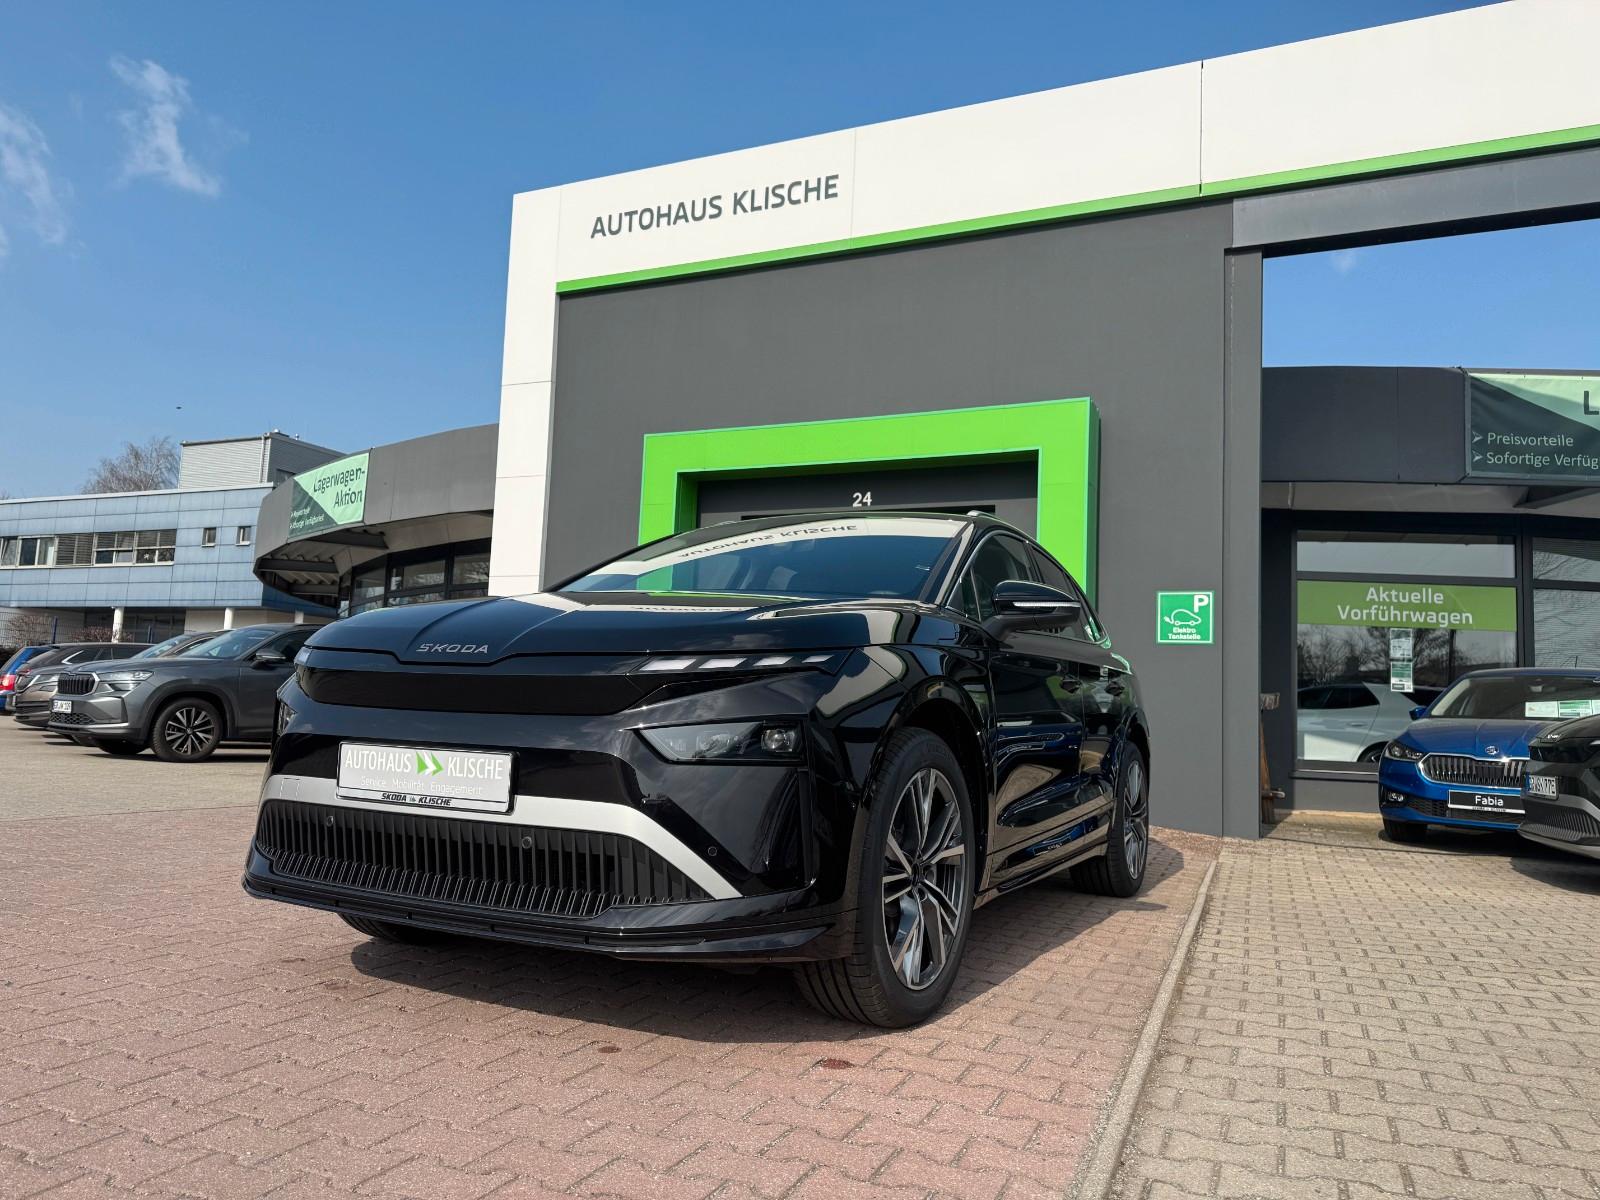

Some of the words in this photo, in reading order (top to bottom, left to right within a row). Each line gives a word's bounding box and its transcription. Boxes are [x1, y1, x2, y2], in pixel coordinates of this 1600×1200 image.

[590, 195, 722, 239] AUTOHAUS
[733, 174, 839, 215] KLISCHE
[1487, 432, 1574, 447] Preisvorteile
[1486, 452, 1551, 468] Sofortige
[1554, 453, 1600, 470] Verfüg
[313, 467, 365, 494] Lagerwagen-
[334, 488, 363, 508] Aktion
[852, 491, 873, 508] 24
[1193, 594, 1209, 613] P
[1366, 586, 1444, 604] Aktuelle
[1337, 605, 1473, 628] Vorführwagen
[345, 750, 412, 773] AUTOHAUS
[447, 757, 504, 780] KLISCHE
[418, 796, 452, 805] KLISCHE
[1475, 795, 1504, 806] Fabia
